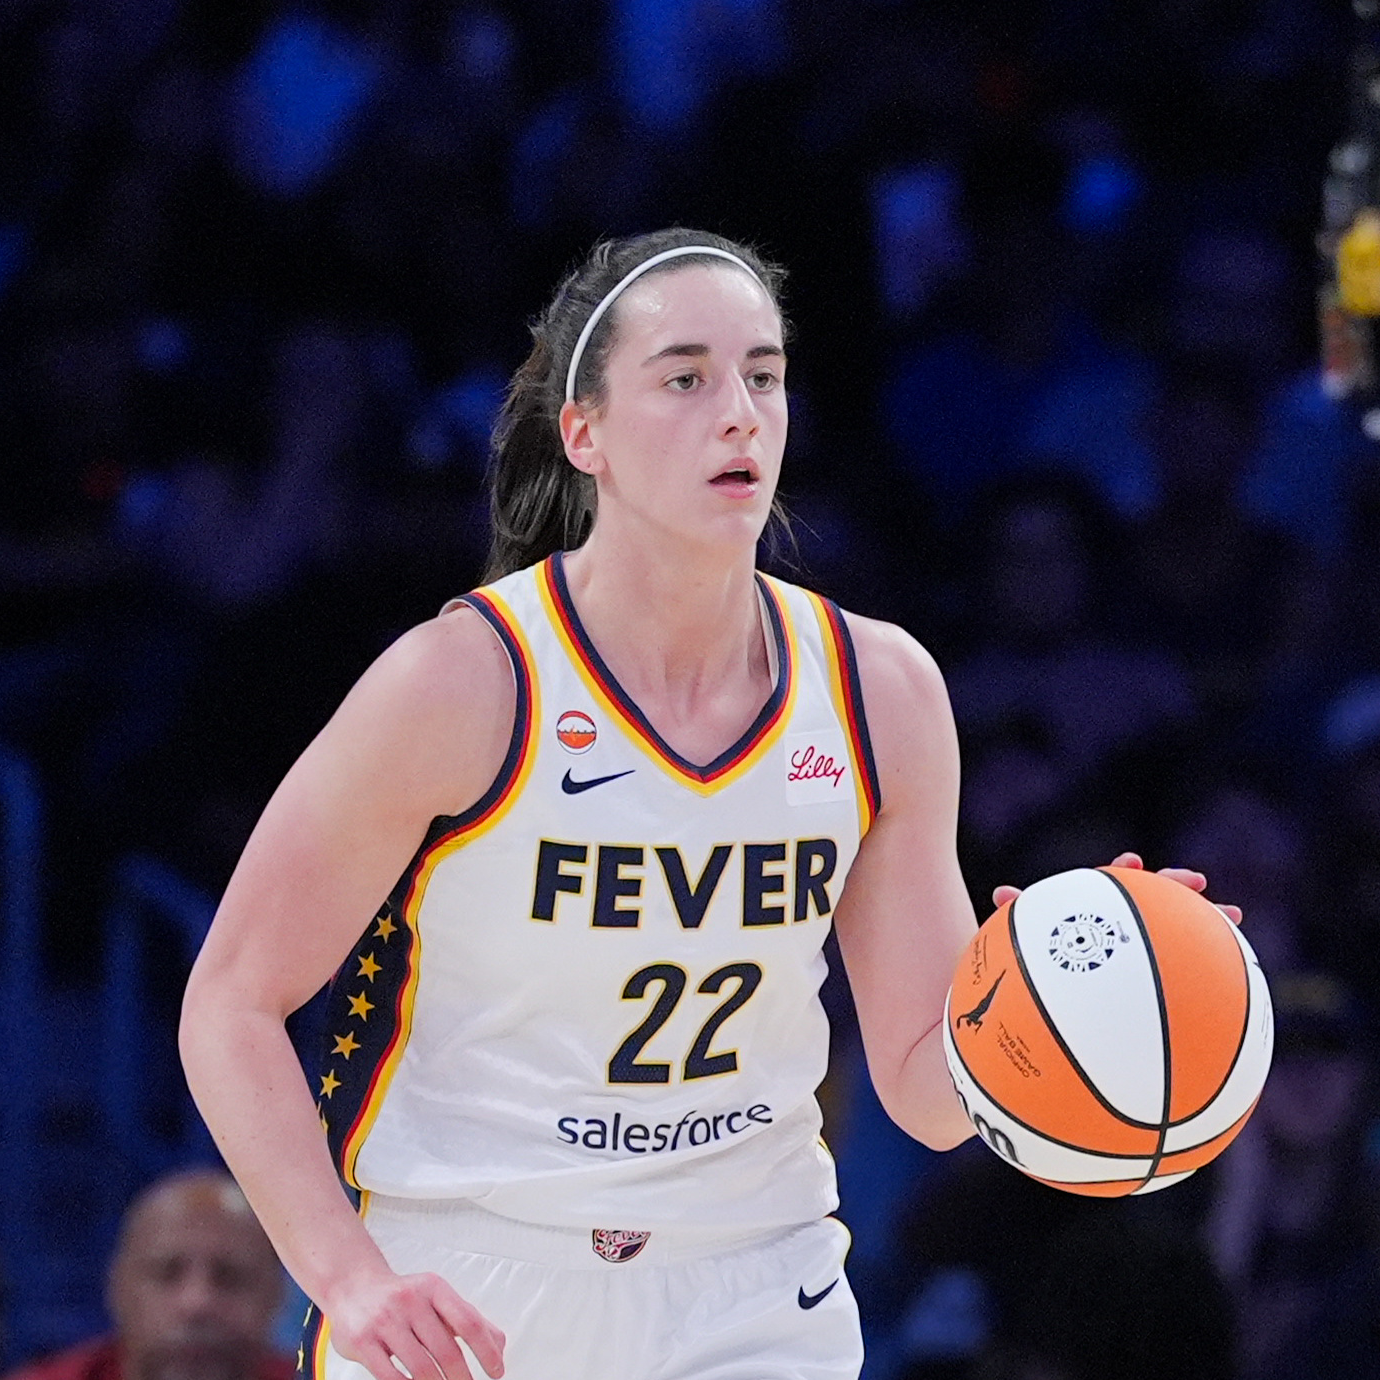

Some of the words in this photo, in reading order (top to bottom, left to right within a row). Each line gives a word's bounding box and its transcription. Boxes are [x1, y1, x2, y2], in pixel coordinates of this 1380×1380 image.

[787, 745, 845, 787] Lilly
[530, 837, 839, 930] FEVER
[604, 960, 765, 1087] 22
[557, 1103, 773, 1153] salesforce
